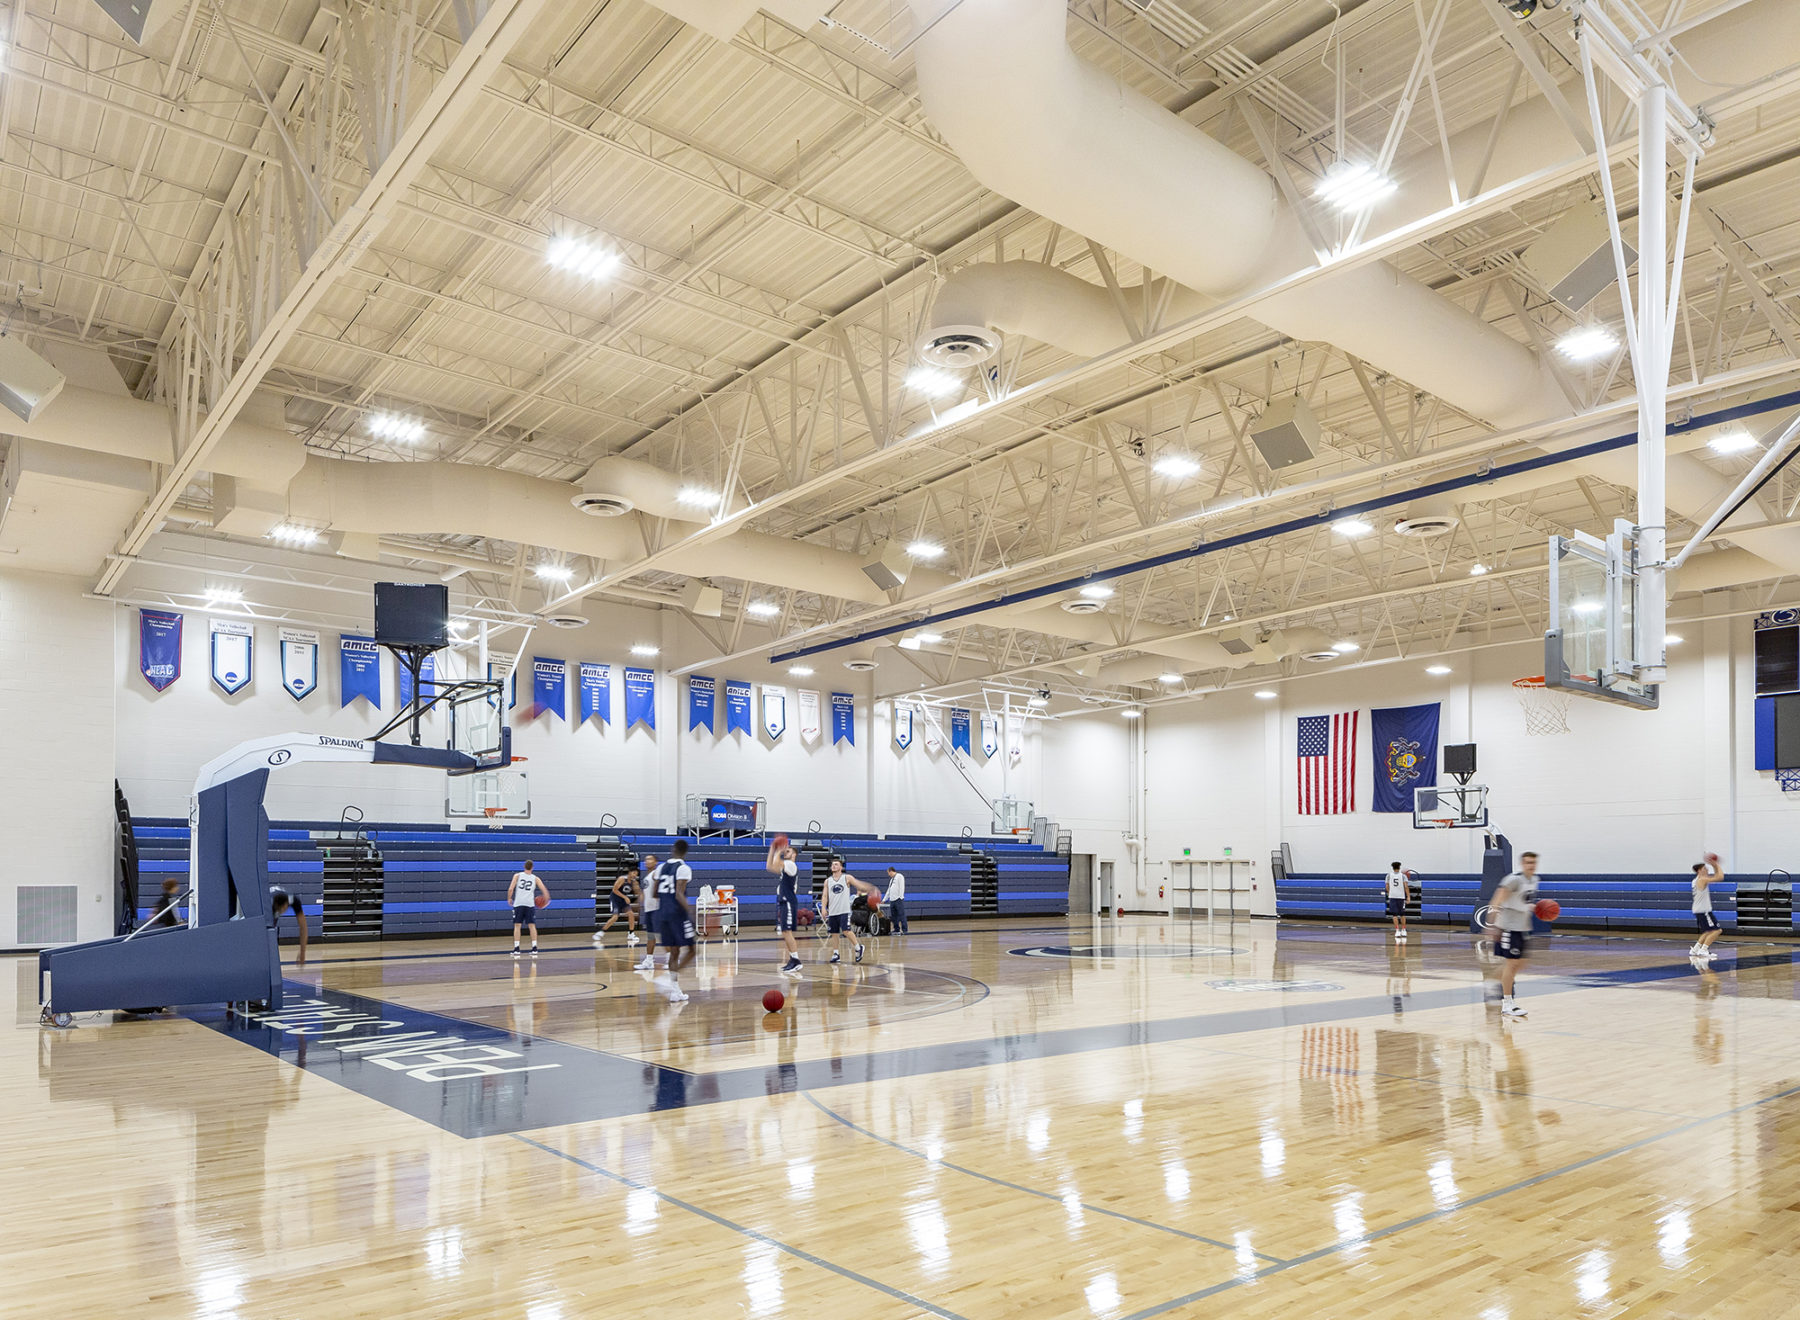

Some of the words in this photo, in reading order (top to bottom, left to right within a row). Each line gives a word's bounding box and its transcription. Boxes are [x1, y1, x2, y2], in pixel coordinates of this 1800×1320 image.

[343, 641, 377, 651] AMCC
[535, 663, 563, 673] AMCC
[627, 672, 653, 681] AMCC
[691, 680, 714, 689] AMCC
[319, 735, 364, 750] SPALDING
[519, 879, 533, 891] 32
[1393, 878, 1399, 887] 5
[317, 1030, 563, 1083] PENN
